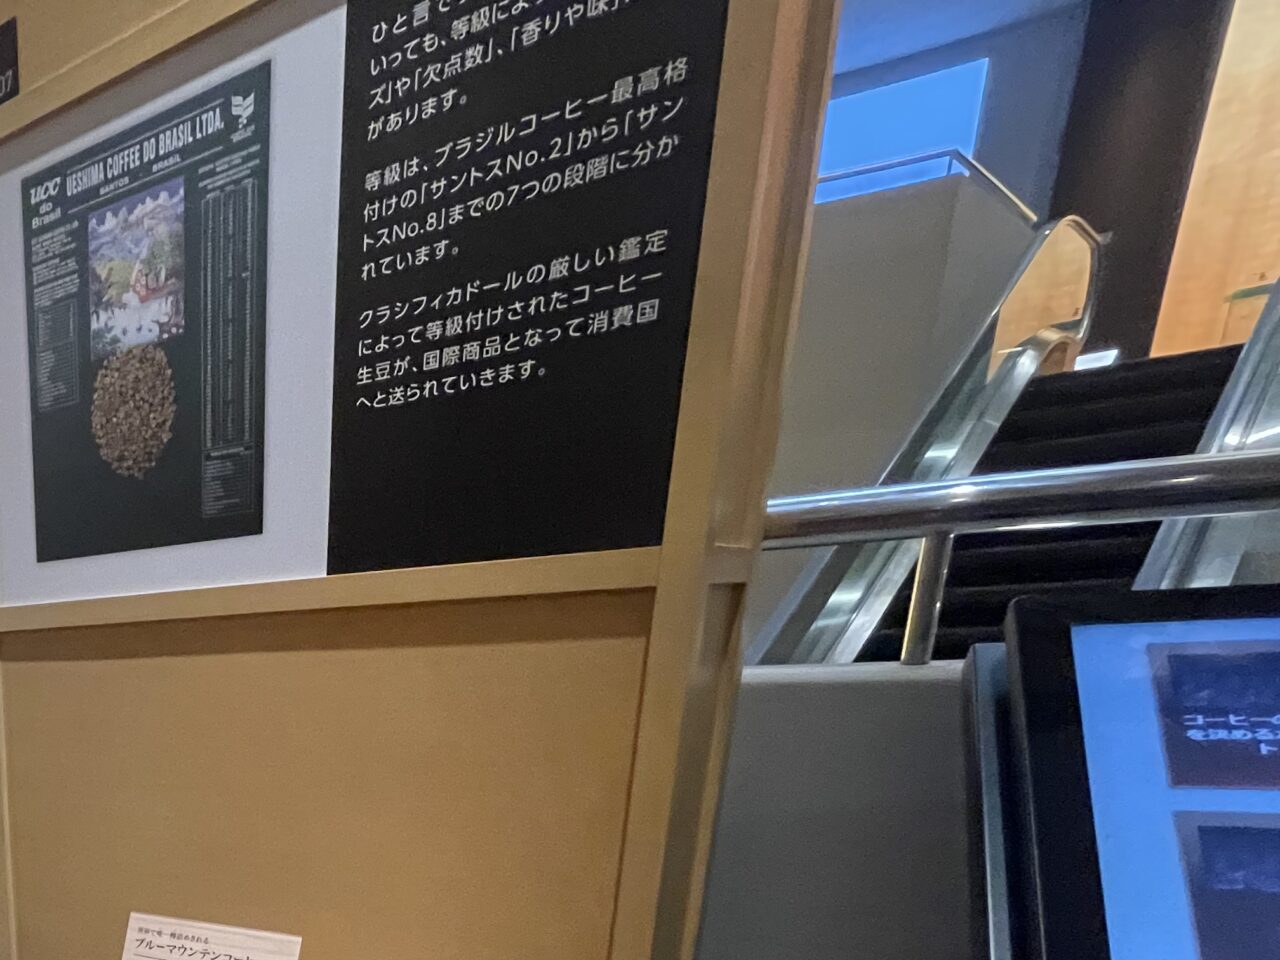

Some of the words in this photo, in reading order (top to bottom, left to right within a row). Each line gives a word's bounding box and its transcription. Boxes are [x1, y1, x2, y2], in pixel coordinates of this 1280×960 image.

[368, 0, 629, 110] ズ」や「欠点数」、「香りや味」
[370, 0, 541, 77] いっても、等級によ
[65, 161, 106, 198] UESHIMA
[106, 146, 141, 184] COFFEE
[142, 140, 156, 164] DO
[158, 121, 194, 157] BRASIL
[195, 106, 225, 141] LTDA.
[363, 56, 689, 193] 等級は、ブラジルコーヒー最高格
[366, 88, 468, 142] があります。
[361, 134, 680, 253] トスNo.8」までの7つの段階に分か
[362, 96, 685, 224] 付けの「サントスNo.2」から「サン
[31, 208, 62, 230] Brasil
[38, 200, 54, 215] do
[358, 228, 670, 329] クラシフィカドールの厳しい鑑定
[360, 239, 460, 282] れています。
[356, 298, 661, 385] 生豆が、国際商品となって消費国
[357, 271, 664, 357] によって等級付けされたコーヒー
[355, 358, 546, 409] へと送られていきます。
